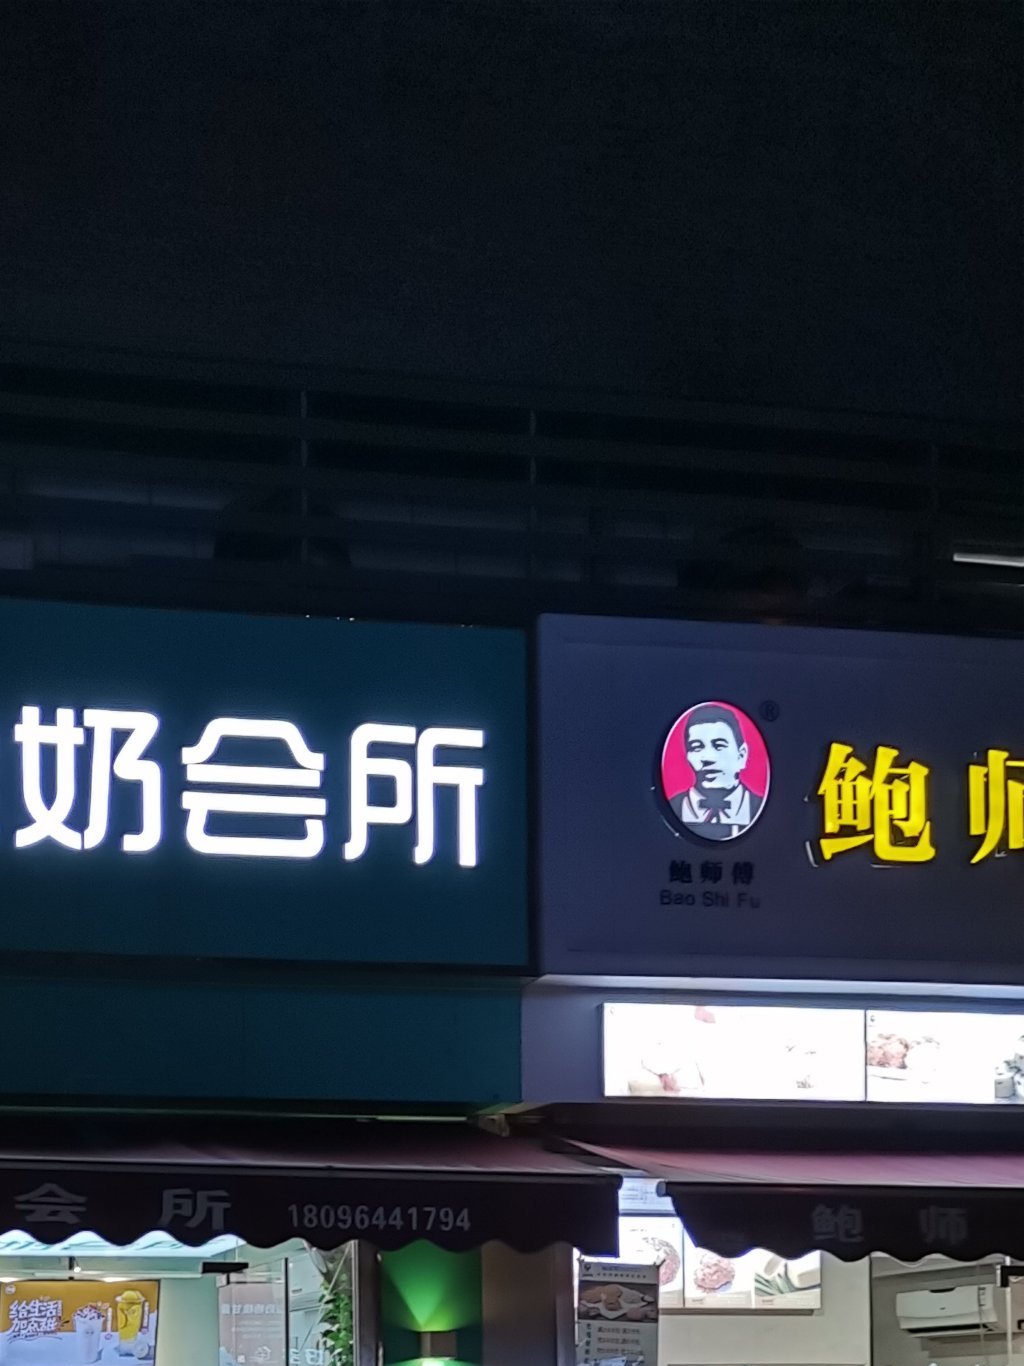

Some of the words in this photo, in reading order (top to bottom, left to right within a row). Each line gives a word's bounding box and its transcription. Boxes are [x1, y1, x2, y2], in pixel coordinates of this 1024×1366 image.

[669, 860, 754, 885] 鲍师傅
[660, 889, 695, 906] Bao
[702, 890, 729, 907] Shi
[737, 892, 760, 909] Fu
[287, 1202, 472, 1233] 18096441794
[812, 1203, 969, 1245] 鲍师
[9, 1299, 58, 1319] 给生活
